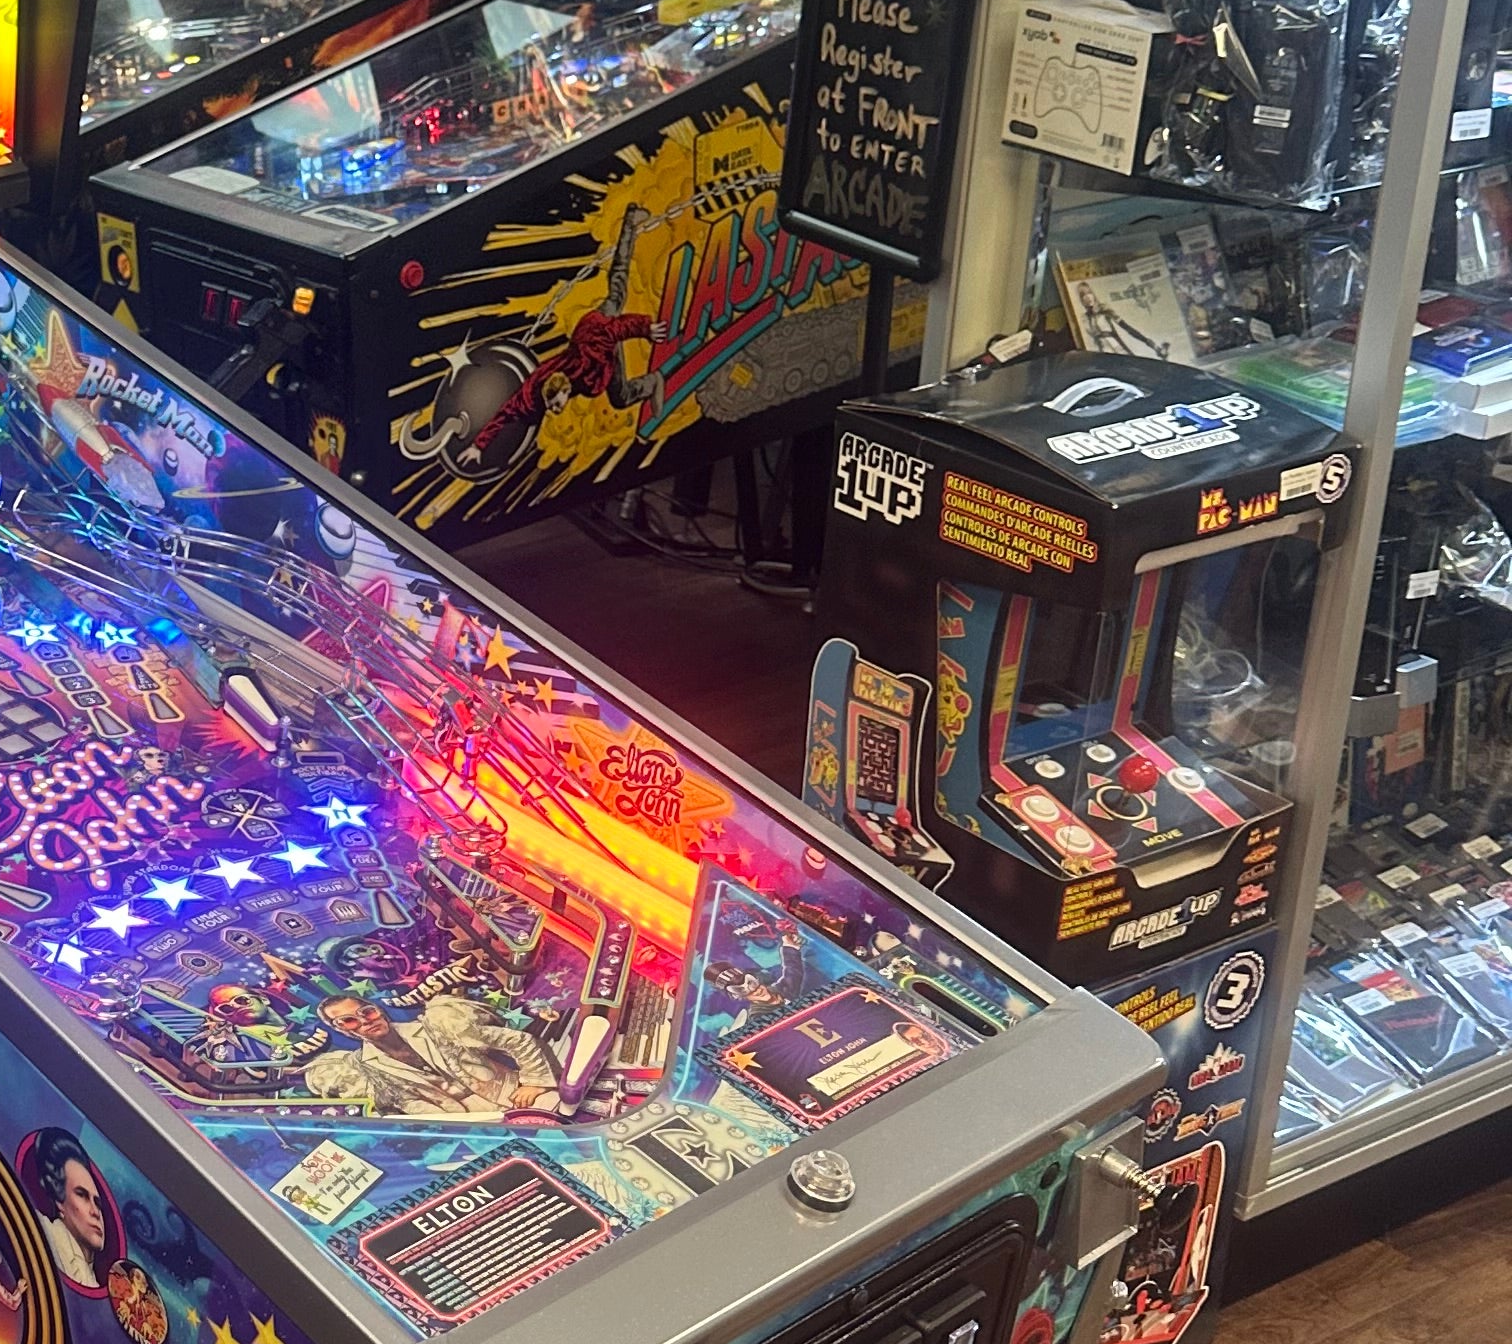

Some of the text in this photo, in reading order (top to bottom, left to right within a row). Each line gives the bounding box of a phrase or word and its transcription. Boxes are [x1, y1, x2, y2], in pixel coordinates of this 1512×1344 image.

[820, 22, 923, 83] Register
[817, 77, 940, 150] at FRONT
[817, 117, 926, 178] to ENTER
[802, 155, 931, 239] ARCADE
[77, 356, 215, 459] Rocket Man
[840, 432, 925, 487] ARCADE
[1322, 465, 1345, 491] 5
[836, 457, 922, 524] 1UP
[947, 475, 1084, 536] REAL FEEL ARCADE CONTROLS
[1198, 492, 1278, 532] PAC-MAN
[942, 525, 1030, 569] SENTIMIENTO REAL
[944, 512, 1071, 569] CONTROLES DE ARCADE CON
[945, 493, 1095, 559] COMMANDES D'ARCADE RÉELLES
[599, 742, 685, 787] Elton
[29, 773, 207, 892] John
[1141, 828, 1184, 847] MOVE
[250, 895, 284, 909] THREE
[311, 883, 344, 895] FOUR
[191, 909, 223, 926] FINAL
[198, 914, 230, 930] TOUR
[152, 938, 177, 953] TWO
[381, 964, 478, 1009] FANTASTIC
[1216, 972, 1251, 1009] 3
[793, 1017, 842, 1049] E
[846, 1036, 868, 1054] JOHN
[411, 1183, 495, 1236] ELTON
